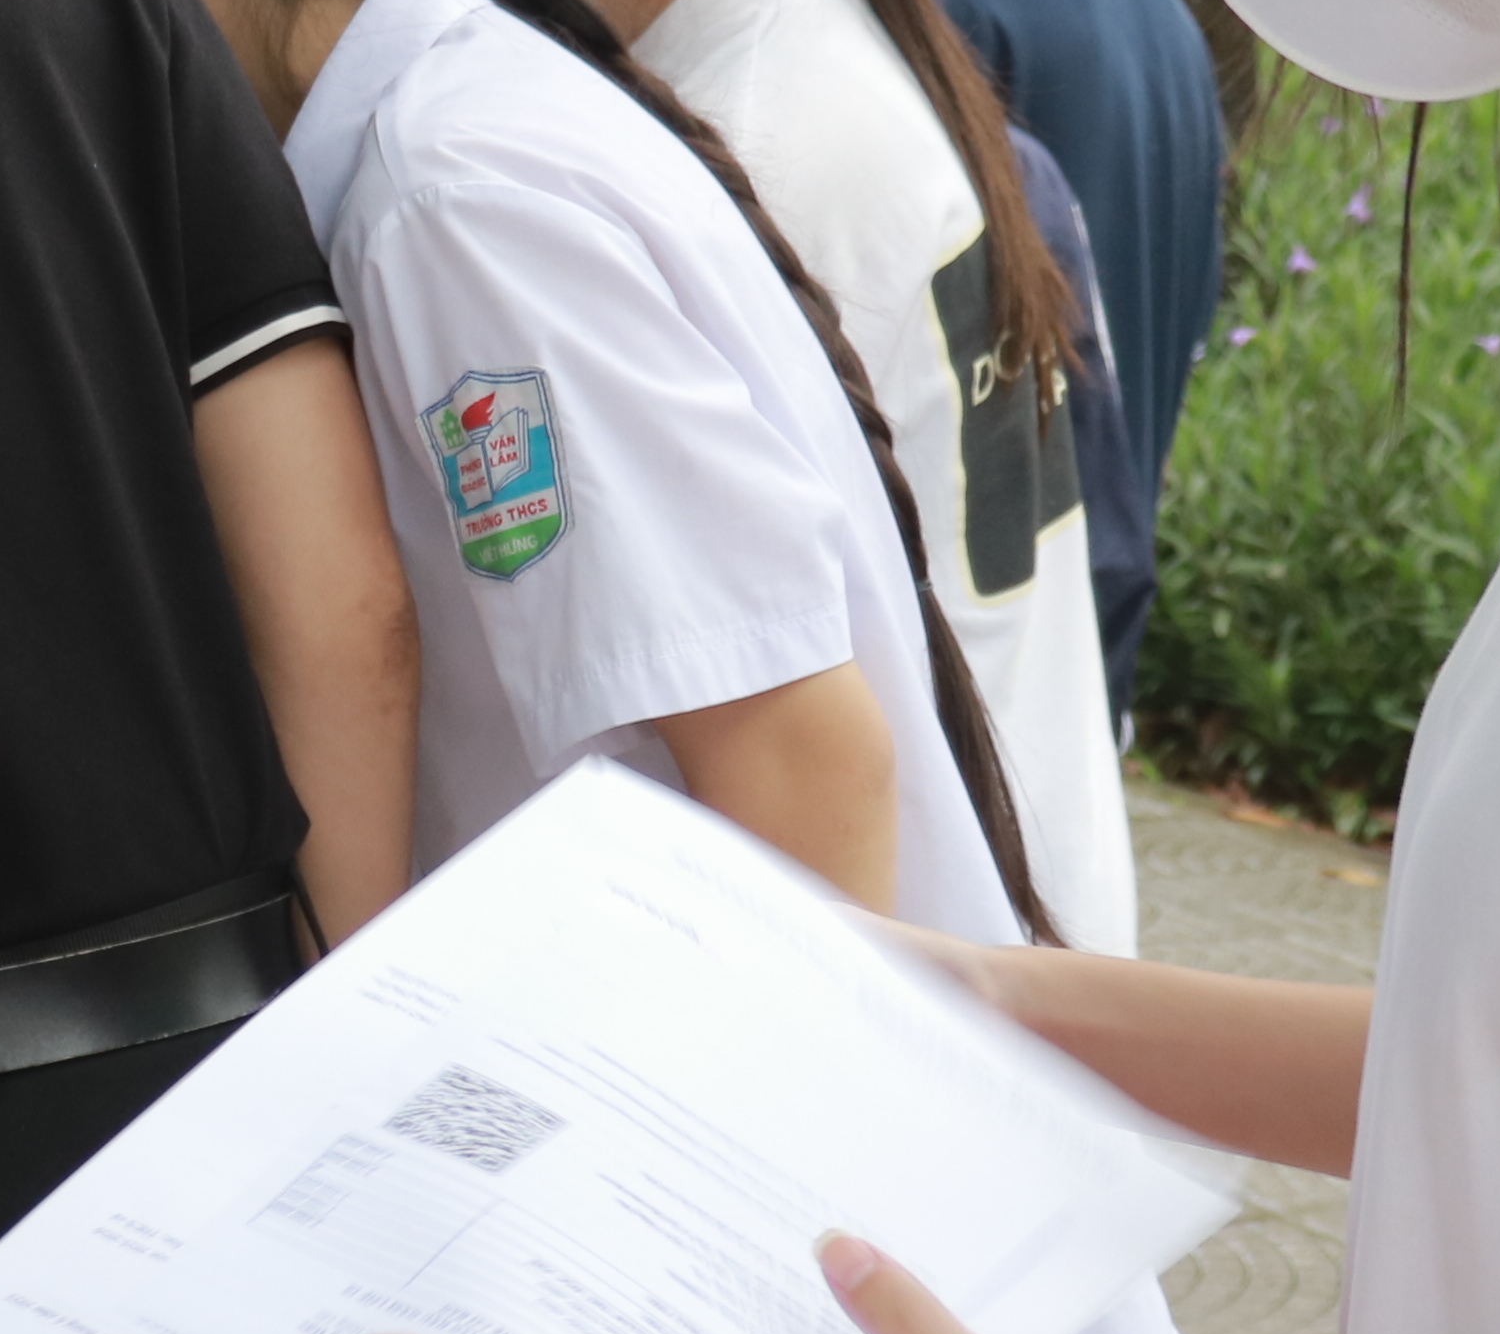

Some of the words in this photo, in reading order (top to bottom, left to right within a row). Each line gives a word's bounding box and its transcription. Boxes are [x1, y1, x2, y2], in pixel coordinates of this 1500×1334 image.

[490, 434, 516, 451] VĂN
[489, 451, 518, 467] LÂM
[466, 513, 503, 537] TRƯỜNG
[507, 498, 548, 521] THCS
